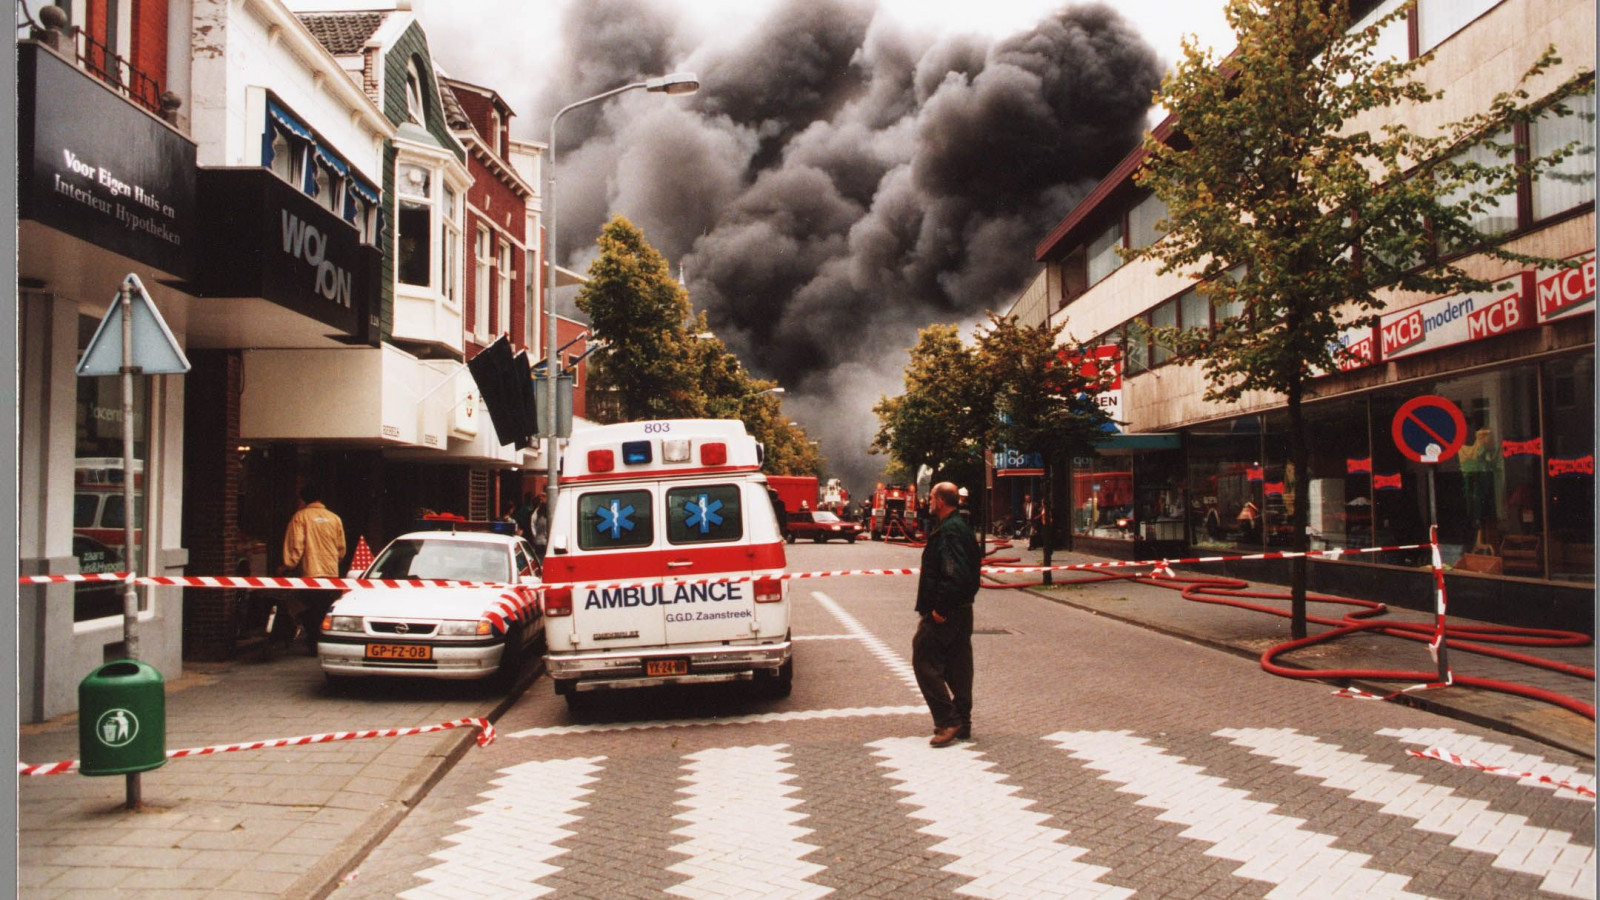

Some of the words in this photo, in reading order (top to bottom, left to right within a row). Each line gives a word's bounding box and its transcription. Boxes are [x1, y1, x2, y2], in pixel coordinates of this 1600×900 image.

[64, 149, 96, 180] Voor
[98, 167, 131, 196] Eigen
[134, 185, 160, 213] Huis
[162, 203, 175, 219] en
[54, 173, 113, 214] Interieur
[115, 203, 181, 246] Hypotheken
[1538, 262, 1596, 315] MCB
[1382, 313, 1422, 354] MCB
[1424, 298, 1475, 334] modern
[1468, 296, 1521, 340] MCB
[644, 422, 670, 434] 803
[584, 582, 743, 611] AMBULANCE
[665, 612, 695, 624] G.G.D.
[696, 609, 753, 621] Zaanstreek
[371, 645, 427, 658] GP-FZ-08
